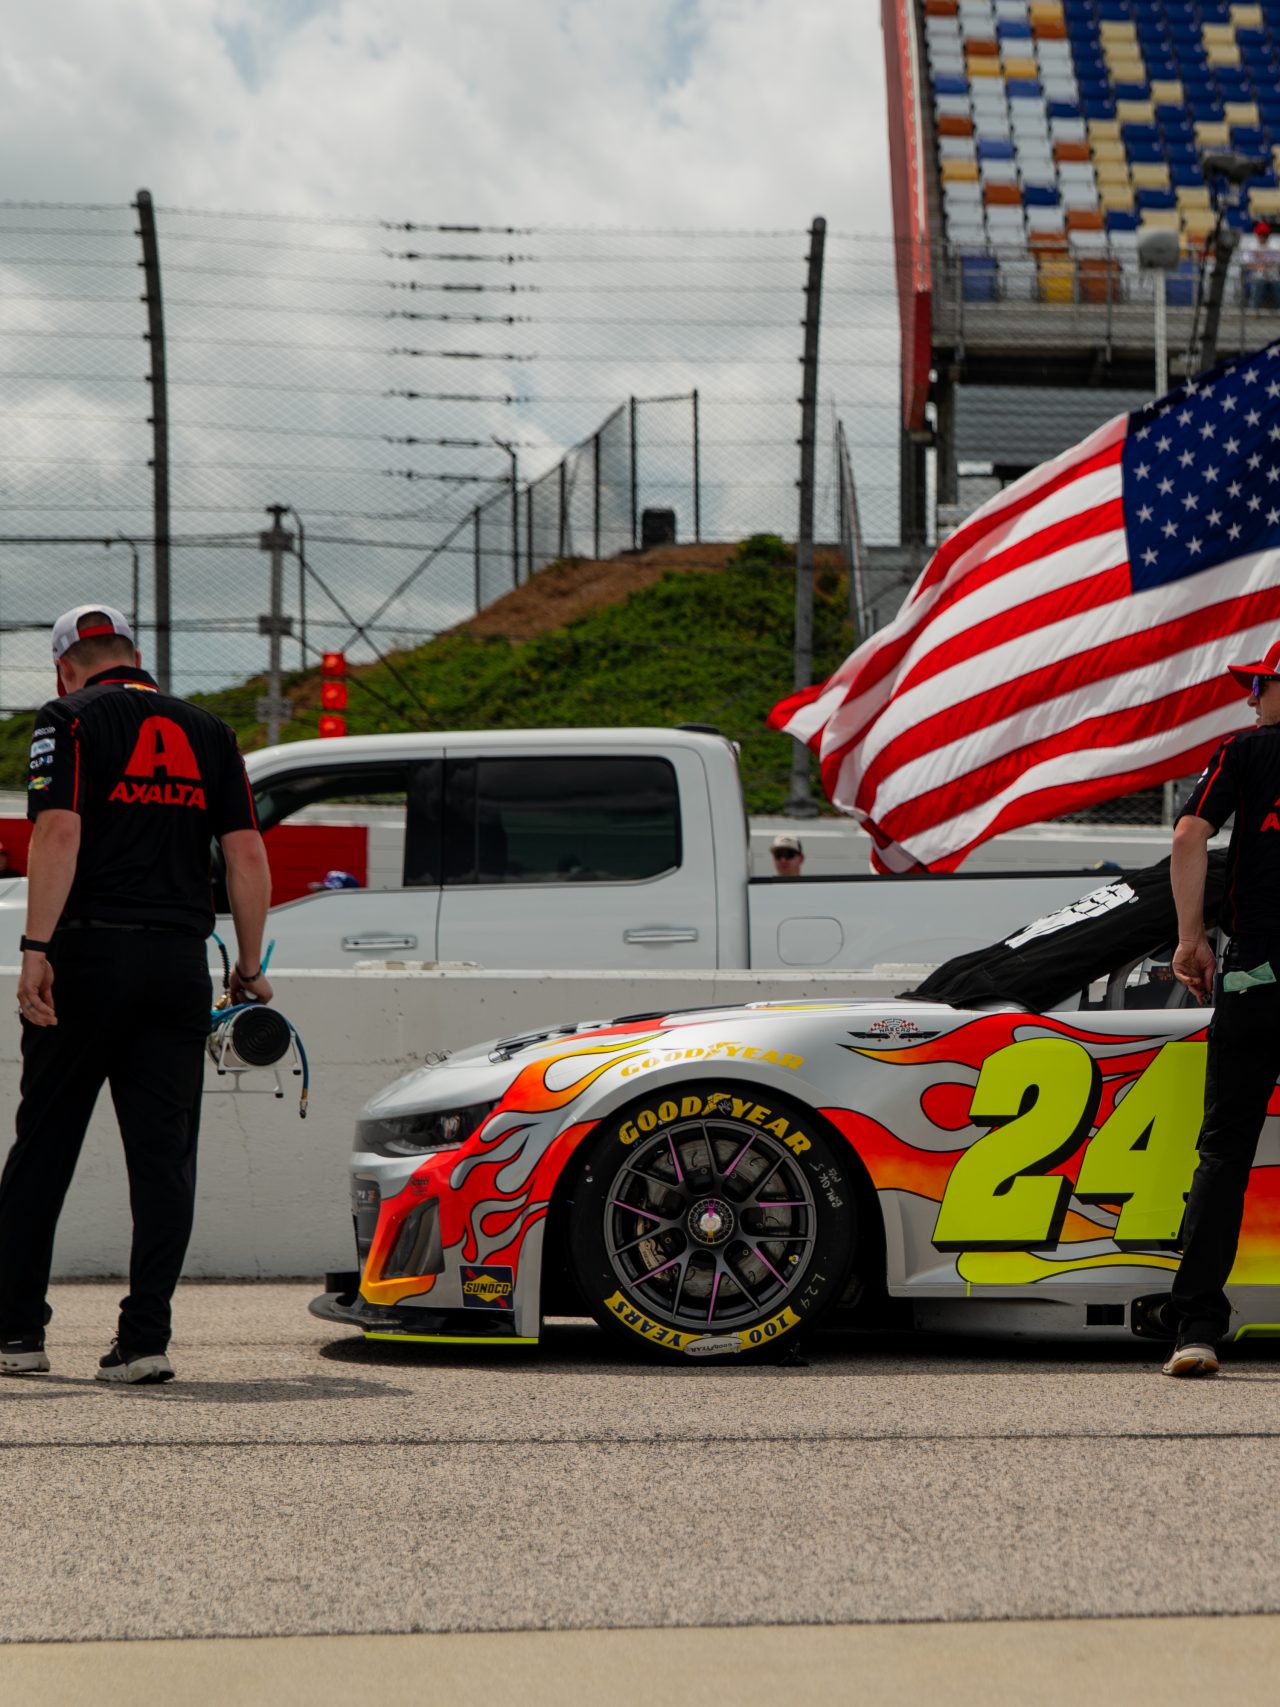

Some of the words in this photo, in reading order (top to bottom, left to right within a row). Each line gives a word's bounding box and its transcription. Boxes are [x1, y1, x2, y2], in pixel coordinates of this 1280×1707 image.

[109, 781, 207, 810] AXALTA
[620, 1041, 806, 1077] GOODYEAR
[618, 1092, 812, 1156] GOODYEAR
[931, 1036, 1209, 1253] 24
[466, 1282, 511, 1295] SUNOCO
[612, 1300, 683, 1348] YEARS
[748, 1313, 790, 1344] 100
